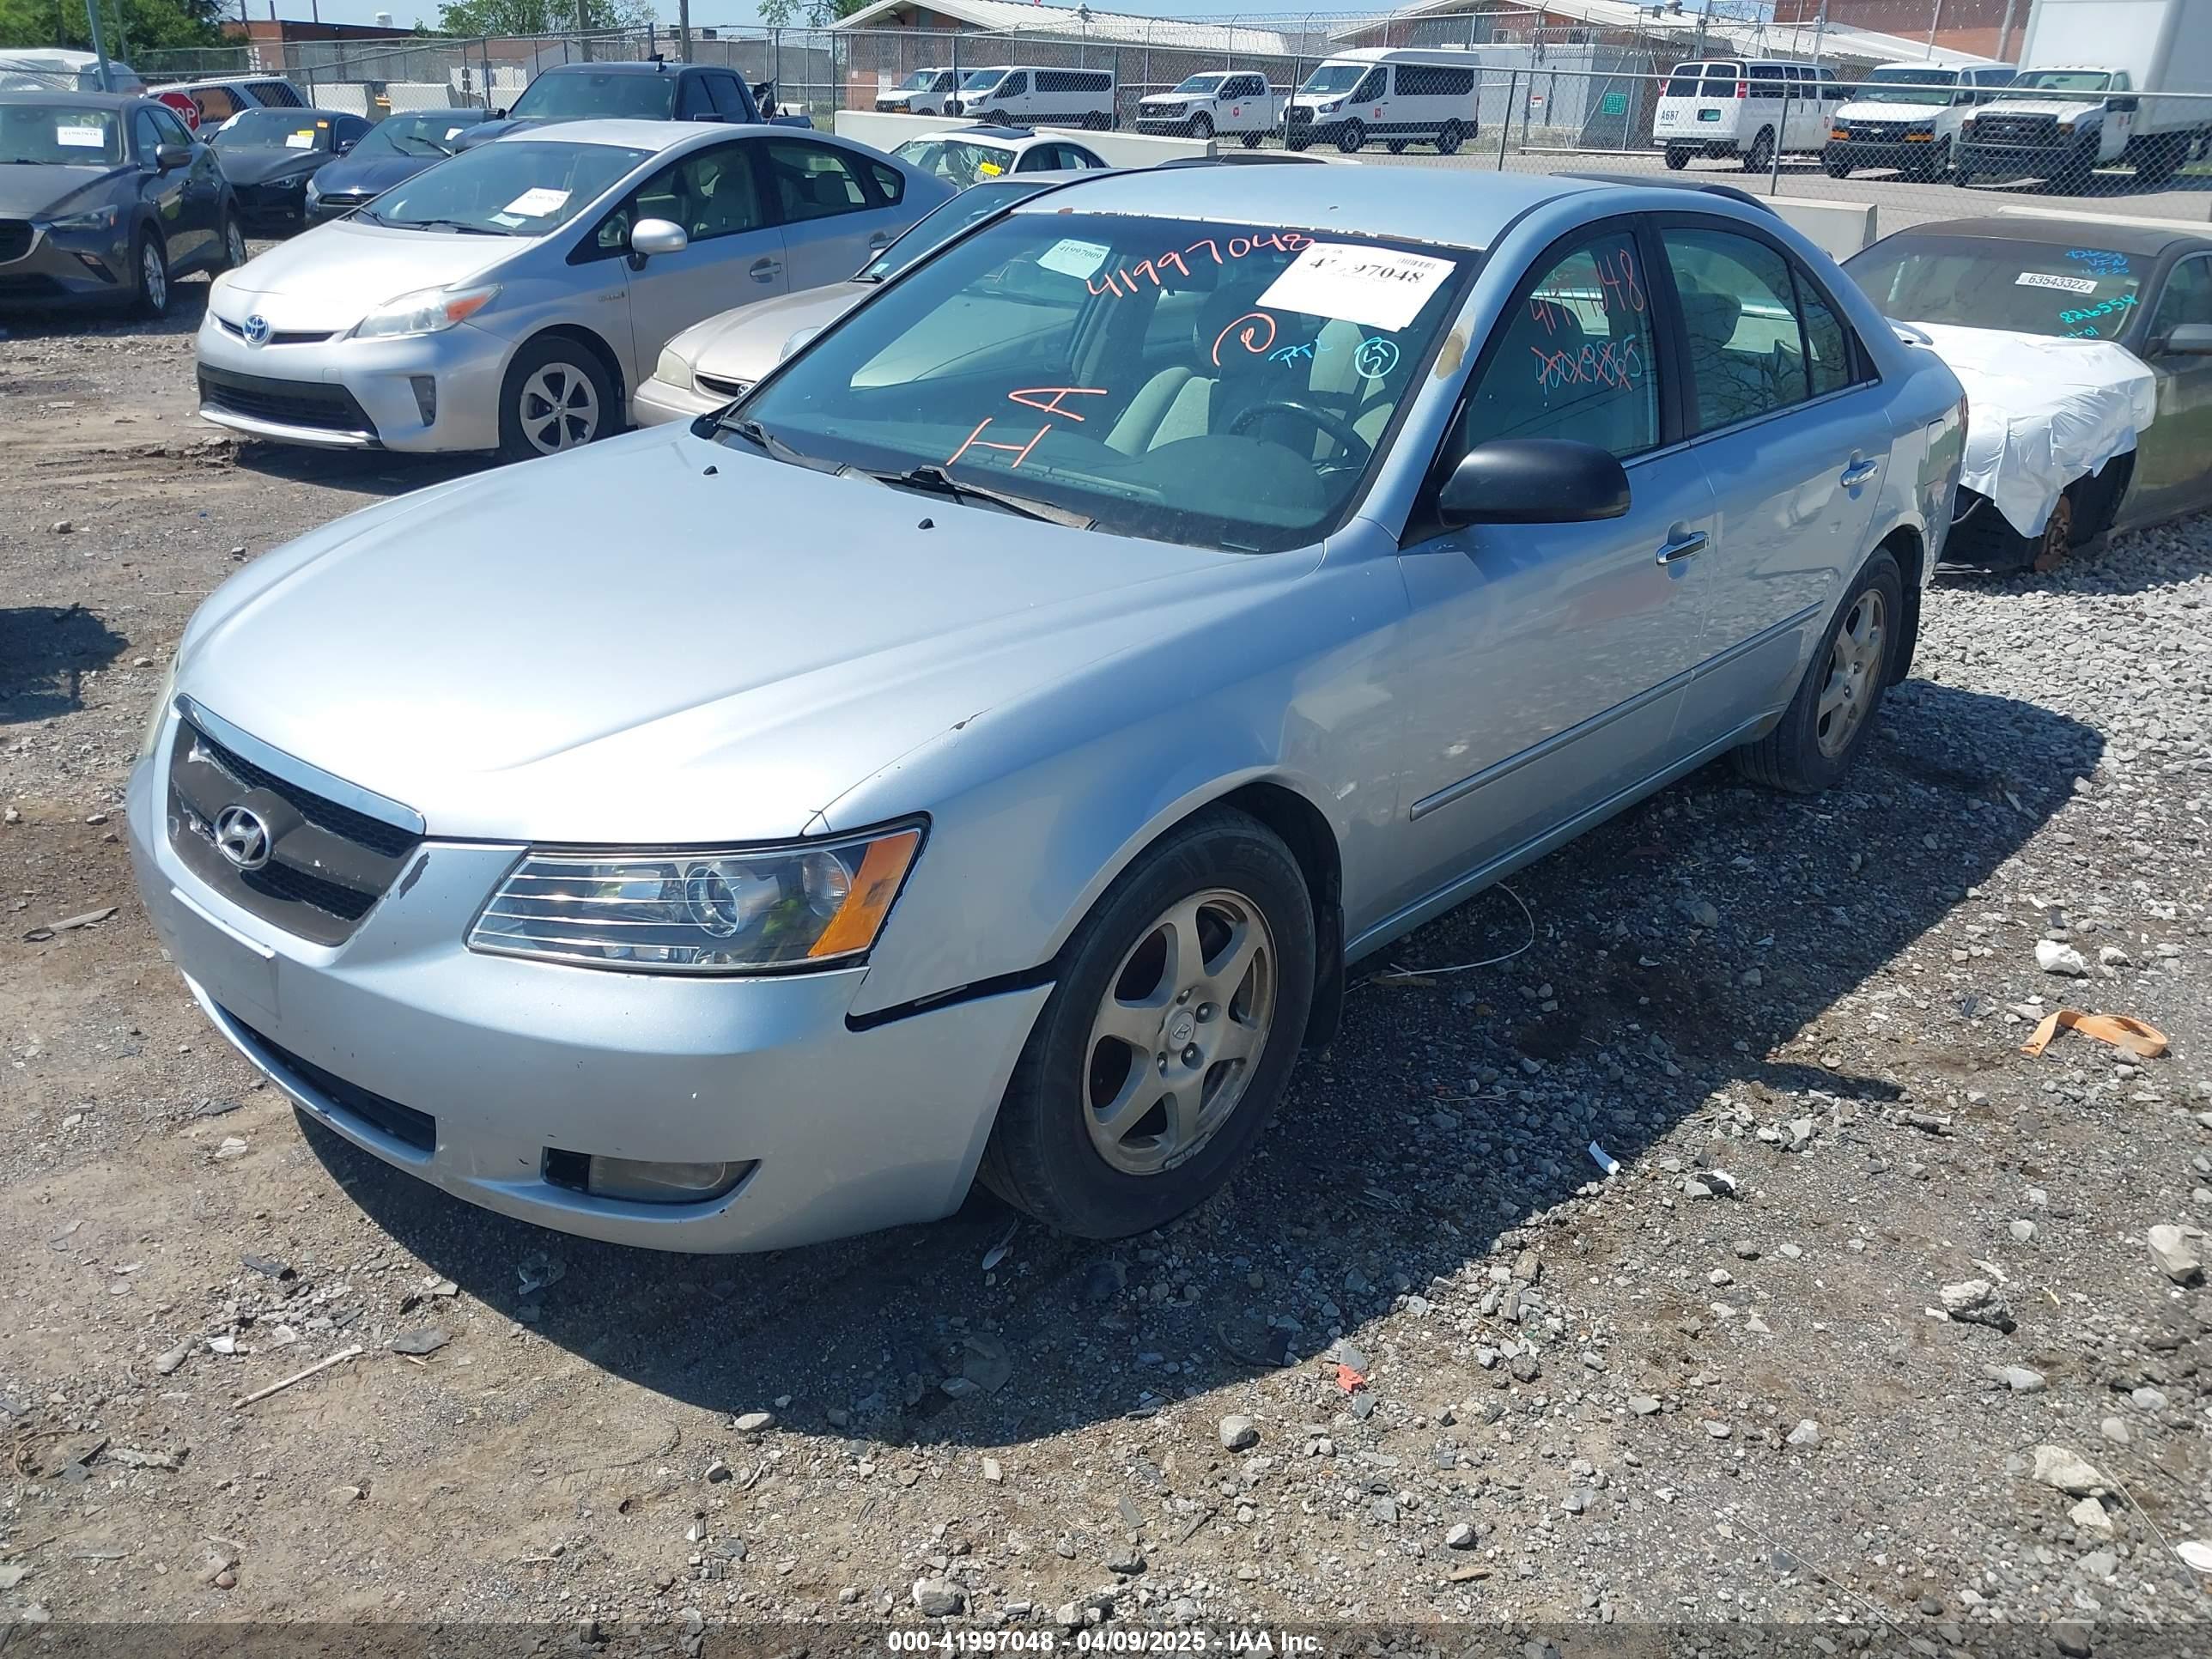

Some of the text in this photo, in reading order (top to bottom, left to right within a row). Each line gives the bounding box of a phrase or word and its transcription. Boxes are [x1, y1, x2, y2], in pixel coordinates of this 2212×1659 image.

[1086, 234, 1316, 297] 41997048
[2028, 275, 2088, 290] 63543322
[2059, 295, 2138, 324] 826554
